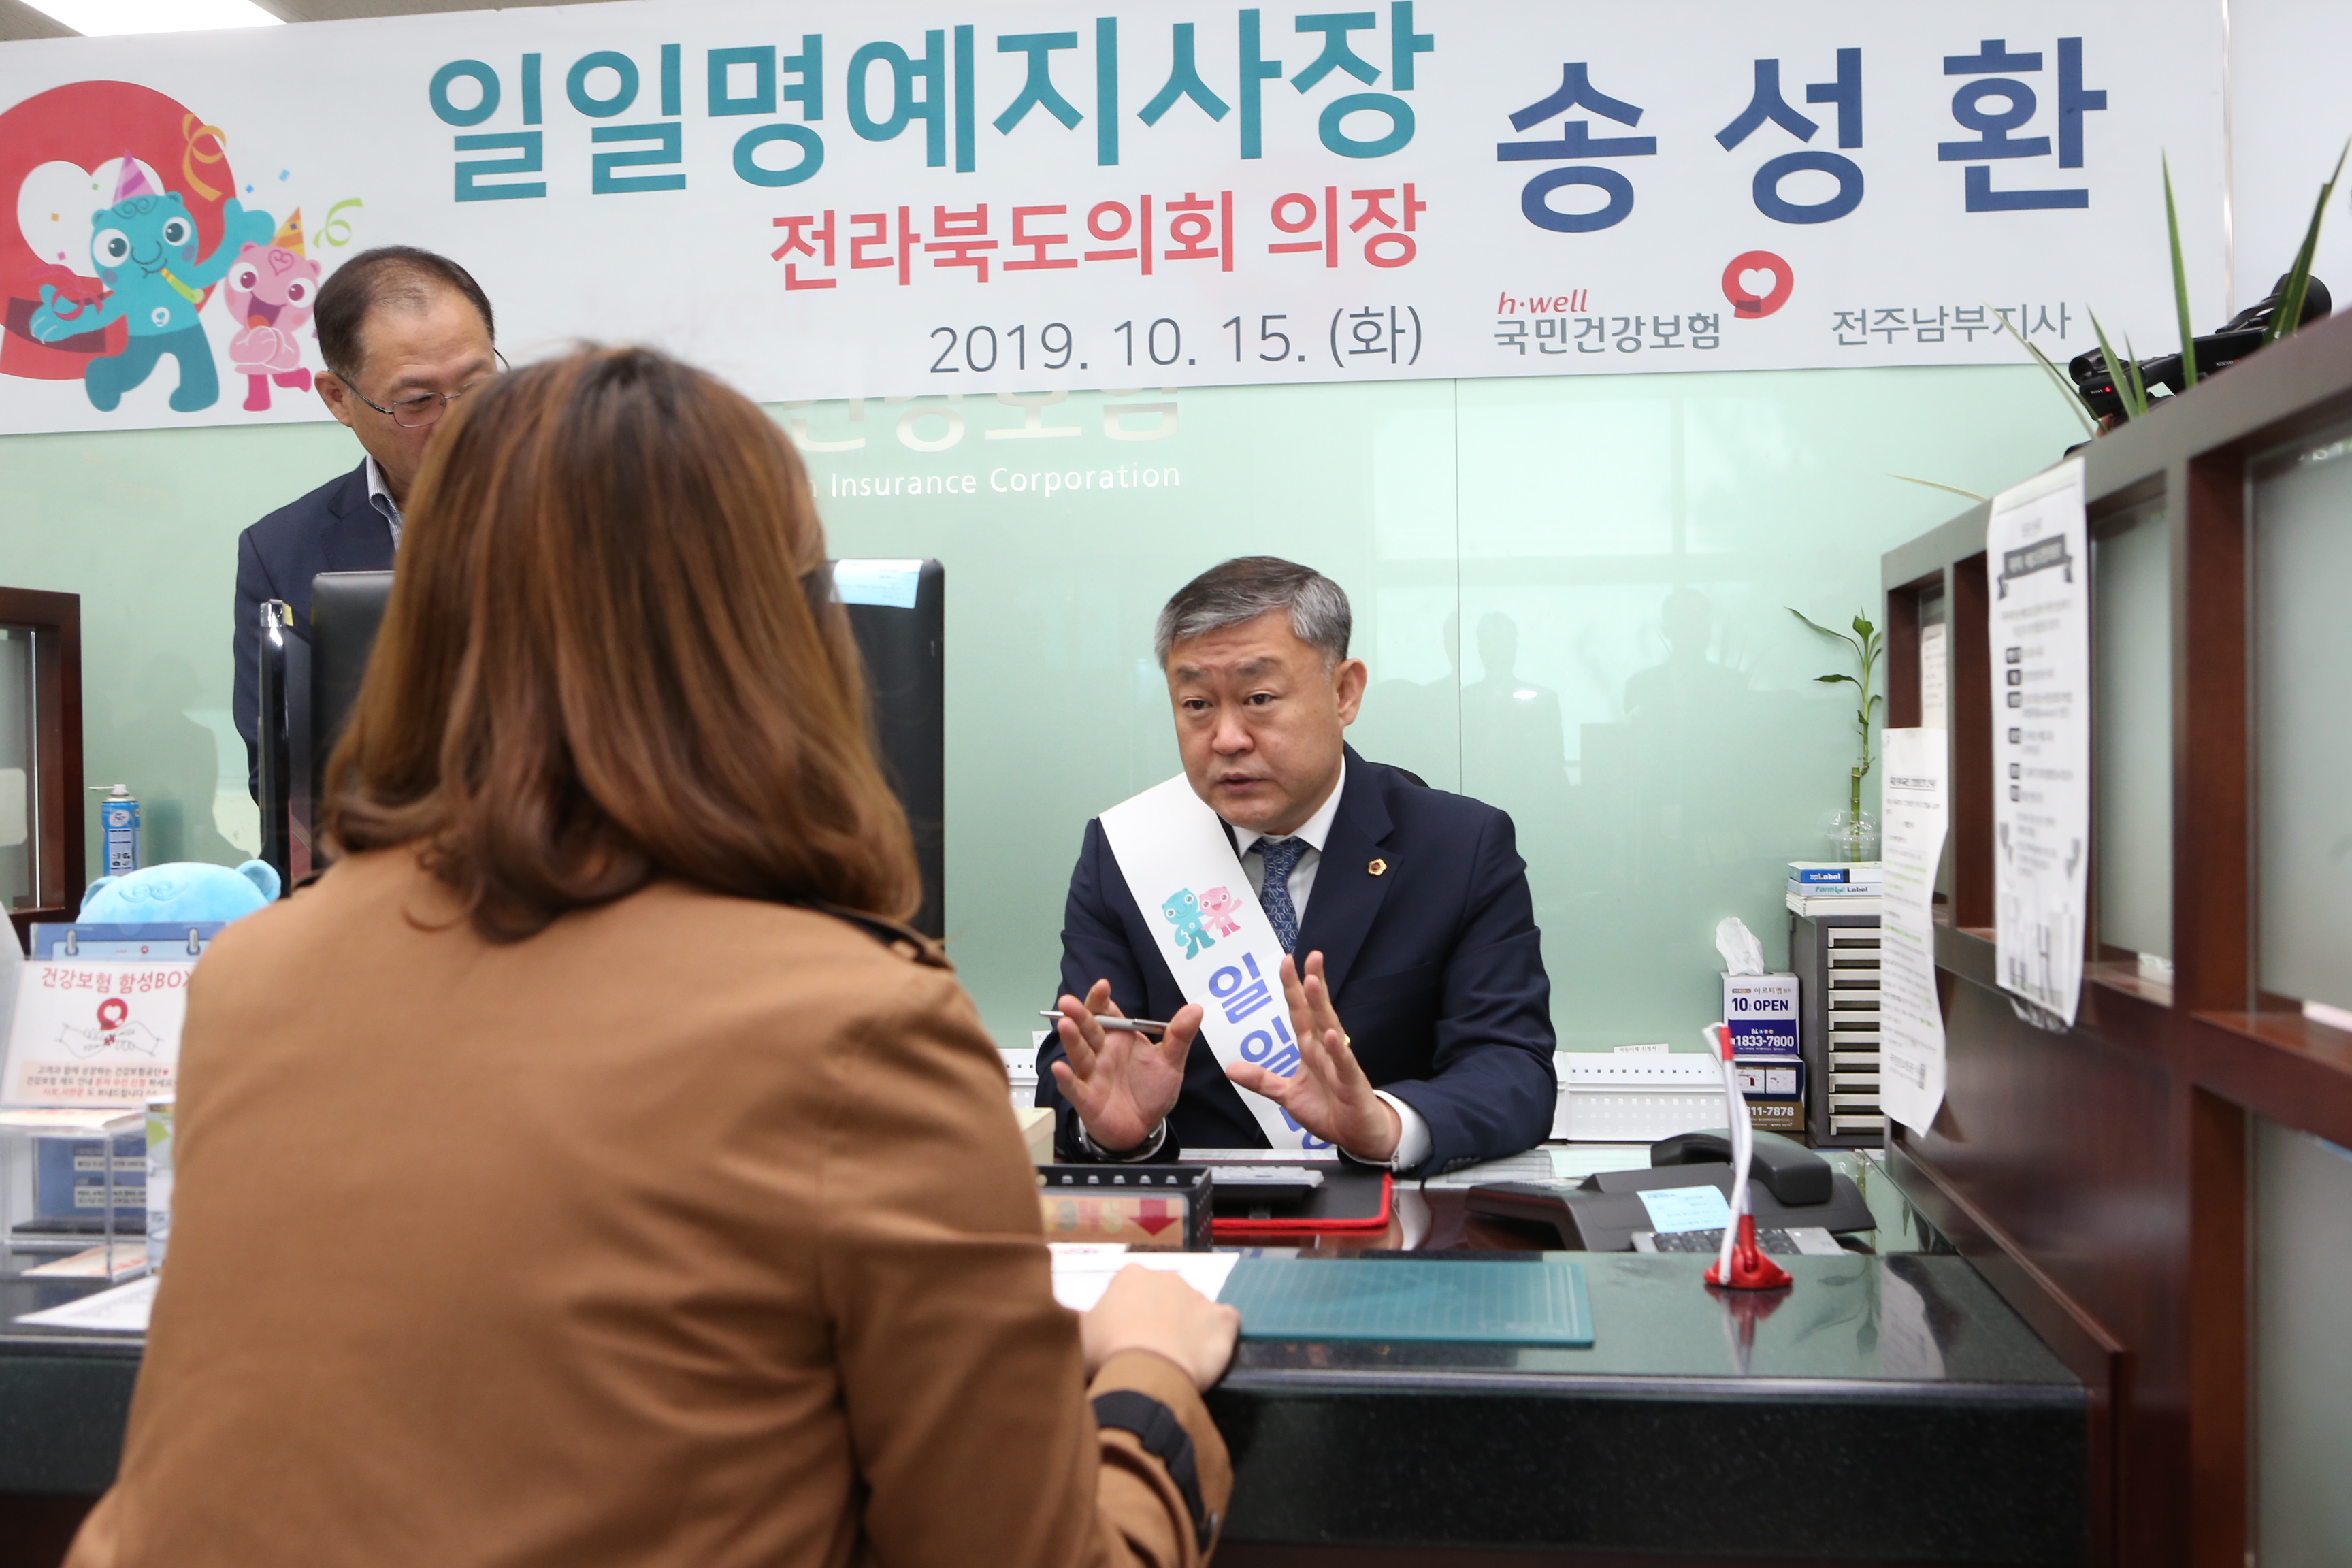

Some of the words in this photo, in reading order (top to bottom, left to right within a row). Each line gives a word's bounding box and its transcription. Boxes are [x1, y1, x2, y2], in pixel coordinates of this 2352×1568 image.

[430, 0, 1434, 202] 일일명예지사장
[770, 190, 1233, 291] 전라북도의회
[1268, 183, 1427, 269] 의장
[930, 323, 1088, 373] 2019.
[1113, 318, 1196, 366] 10.
[1222, 314, 1306, 363] 15.
[1329, 306, 1422, 368] (화)
[1494, 312, 1720, 355] 국민건강보험
[1831, 301, 2072, 346] 전주남부지사
[831, 473, 977, 497] Insurance
[990, 462, 1180, 498] Corporation
[42, 967, 112, 994] 건강보험
[1754, 1000, 1789, 1011] OPEN
[1735, 1035, 1795, 1047] 1833-7800
